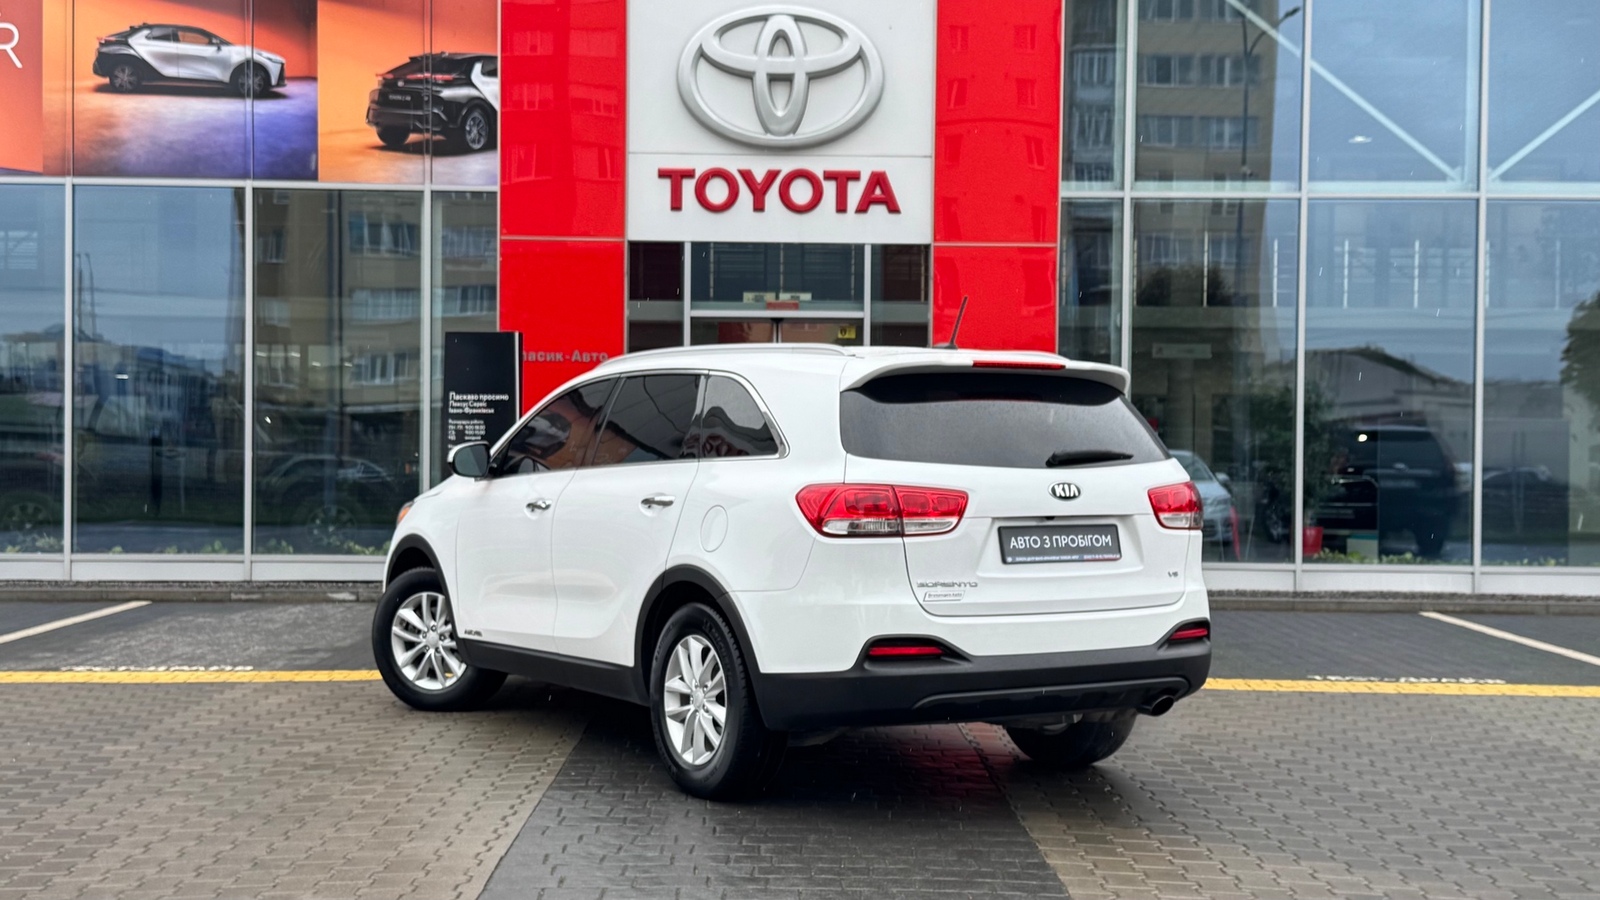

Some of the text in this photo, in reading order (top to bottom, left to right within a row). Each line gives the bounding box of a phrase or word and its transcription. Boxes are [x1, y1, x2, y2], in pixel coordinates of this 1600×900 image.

[658, 167, 902, 214] TOYOTA
[1053, 483, 1080, 498] KIA
[1010, 535, 1042, 550] АВТО
[1052, 534, 1113, 549] ПРОБІГОМ
